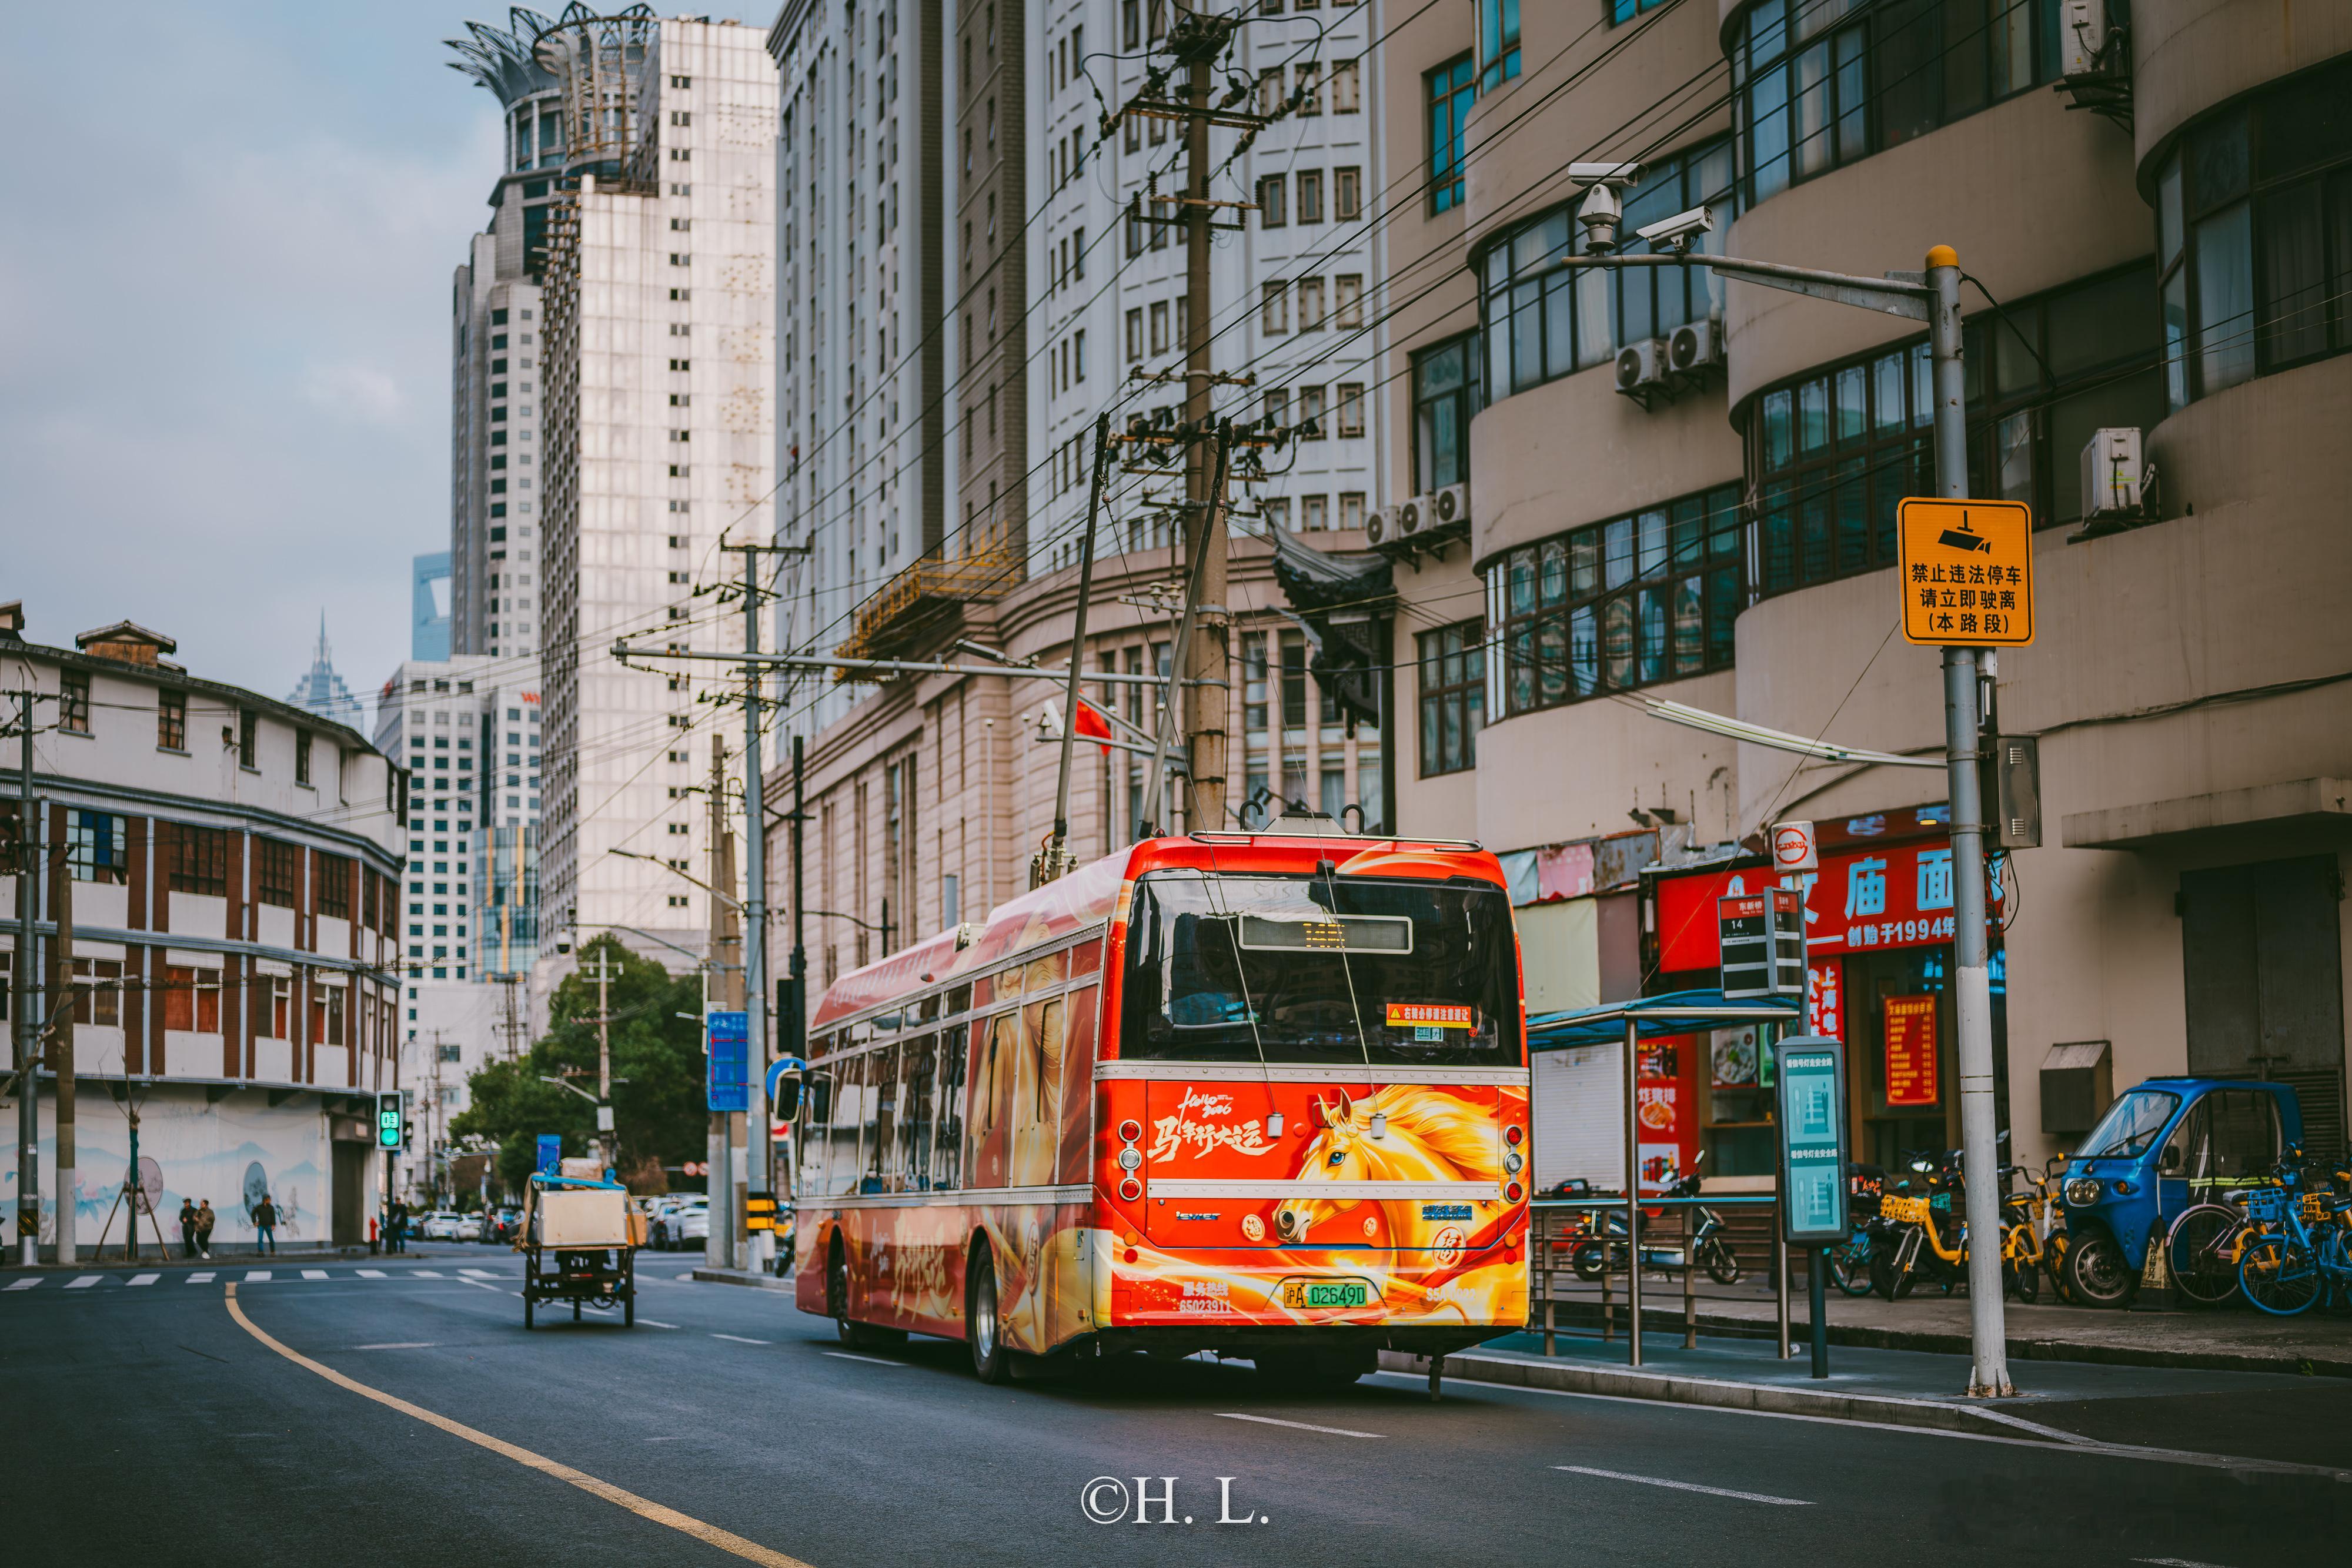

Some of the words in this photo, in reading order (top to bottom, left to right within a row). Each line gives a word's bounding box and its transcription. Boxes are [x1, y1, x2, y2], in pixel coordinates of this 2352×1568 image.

[1912, 563, 2022, 586] 禁止违法停车
[1920, 588, 2015, 610] 请立即驶离
[1732, 920, 1743, 930] 14
[1776, 913, 1782, 922] 14
[1847, 917, 1954, 947] 创始于1994年
[1786, 1057, 1833, 1068] 看信号灯走安全路
[1147, 1116, 1278, 1164] 马年行大运
[1182, 1281, 1229, 1297] 服务热线
[1179, 1299, 1232, 1313] 65023911
